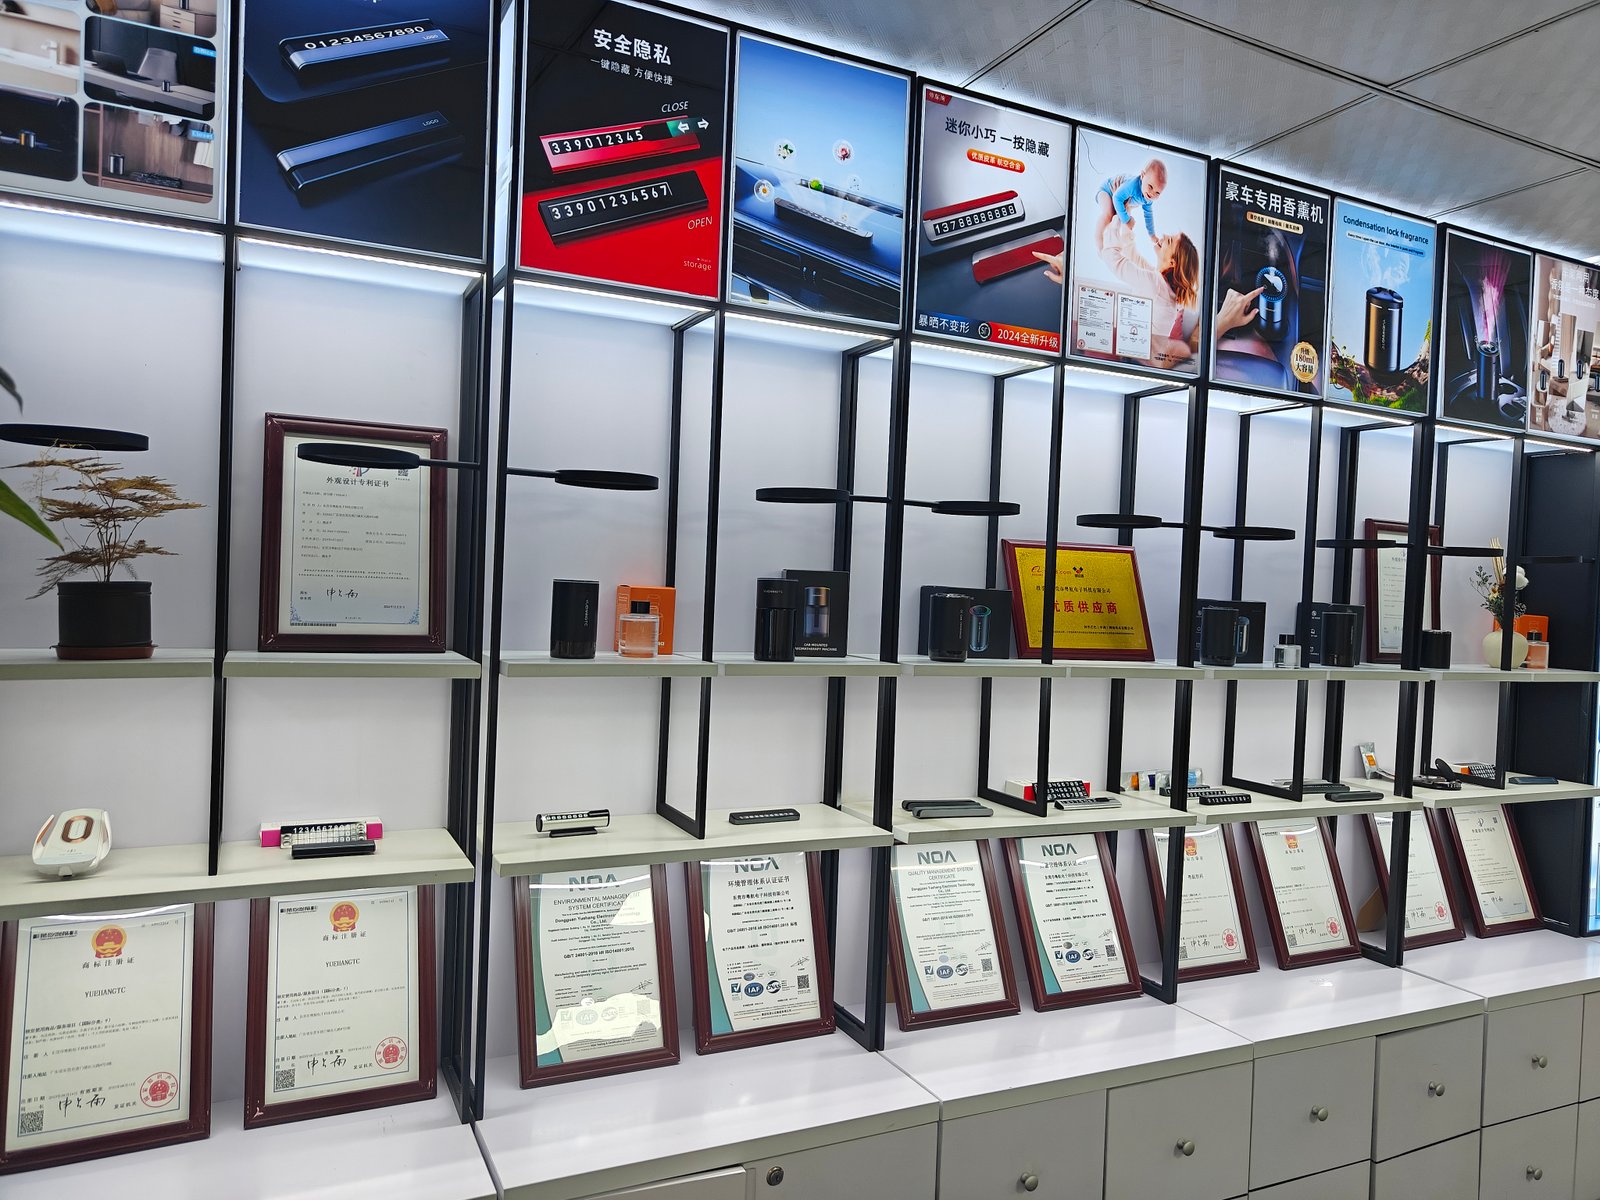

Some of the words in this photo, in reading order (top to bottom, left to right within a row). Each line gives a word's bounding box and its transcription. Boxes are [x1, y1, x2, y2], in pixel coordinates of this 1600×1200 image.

[304, 26, 425, 50] 01234567890
[594, 28, 672, 66] 安全隐私
[591, 58, 630, 76] 一键隐藏
[634, 67, 673, 86] 方便快捷
[661, 100, 689, 113] CLOSE
[552, 130, 644, 154] 339012345
[944, 116, 996, 142] 迷你小巧
[1000, 134, 1050, 158] 一按隐藏
[552, 184, 668, 220] 33901234567
[1225, 181, 1324, 224] 豪车专用香薰机
[688, 216, 713, 230] OPEN
[934, 205, 1016, 234] 13788888888
[1343, 216, 1385, 234] Condensation
[1387, 226, 1399, 236] lock
[1400, 230, 1429, 244] fragrance
[684, 260, 712, 271] storage
[918, 314, 970, 334] 暴晒不变形
[997, 328, 1058, 348] 2024全新升级
[1295, 354, 1315, 365] 180ml
[1295, 363, 1314, 374] 大容量
[326, 476, 389, 487] 外观设计专利证书
[728, 876, 790, 887] 环境管理体系认证证书
[554, 896, 601, 905] ENVIRONMENTAL
[602, 892, 640, 900] MANAGEMNT
[322, 931, 366, 942] 商标注册证
[82, 957, 134, 969] 商标注册证
